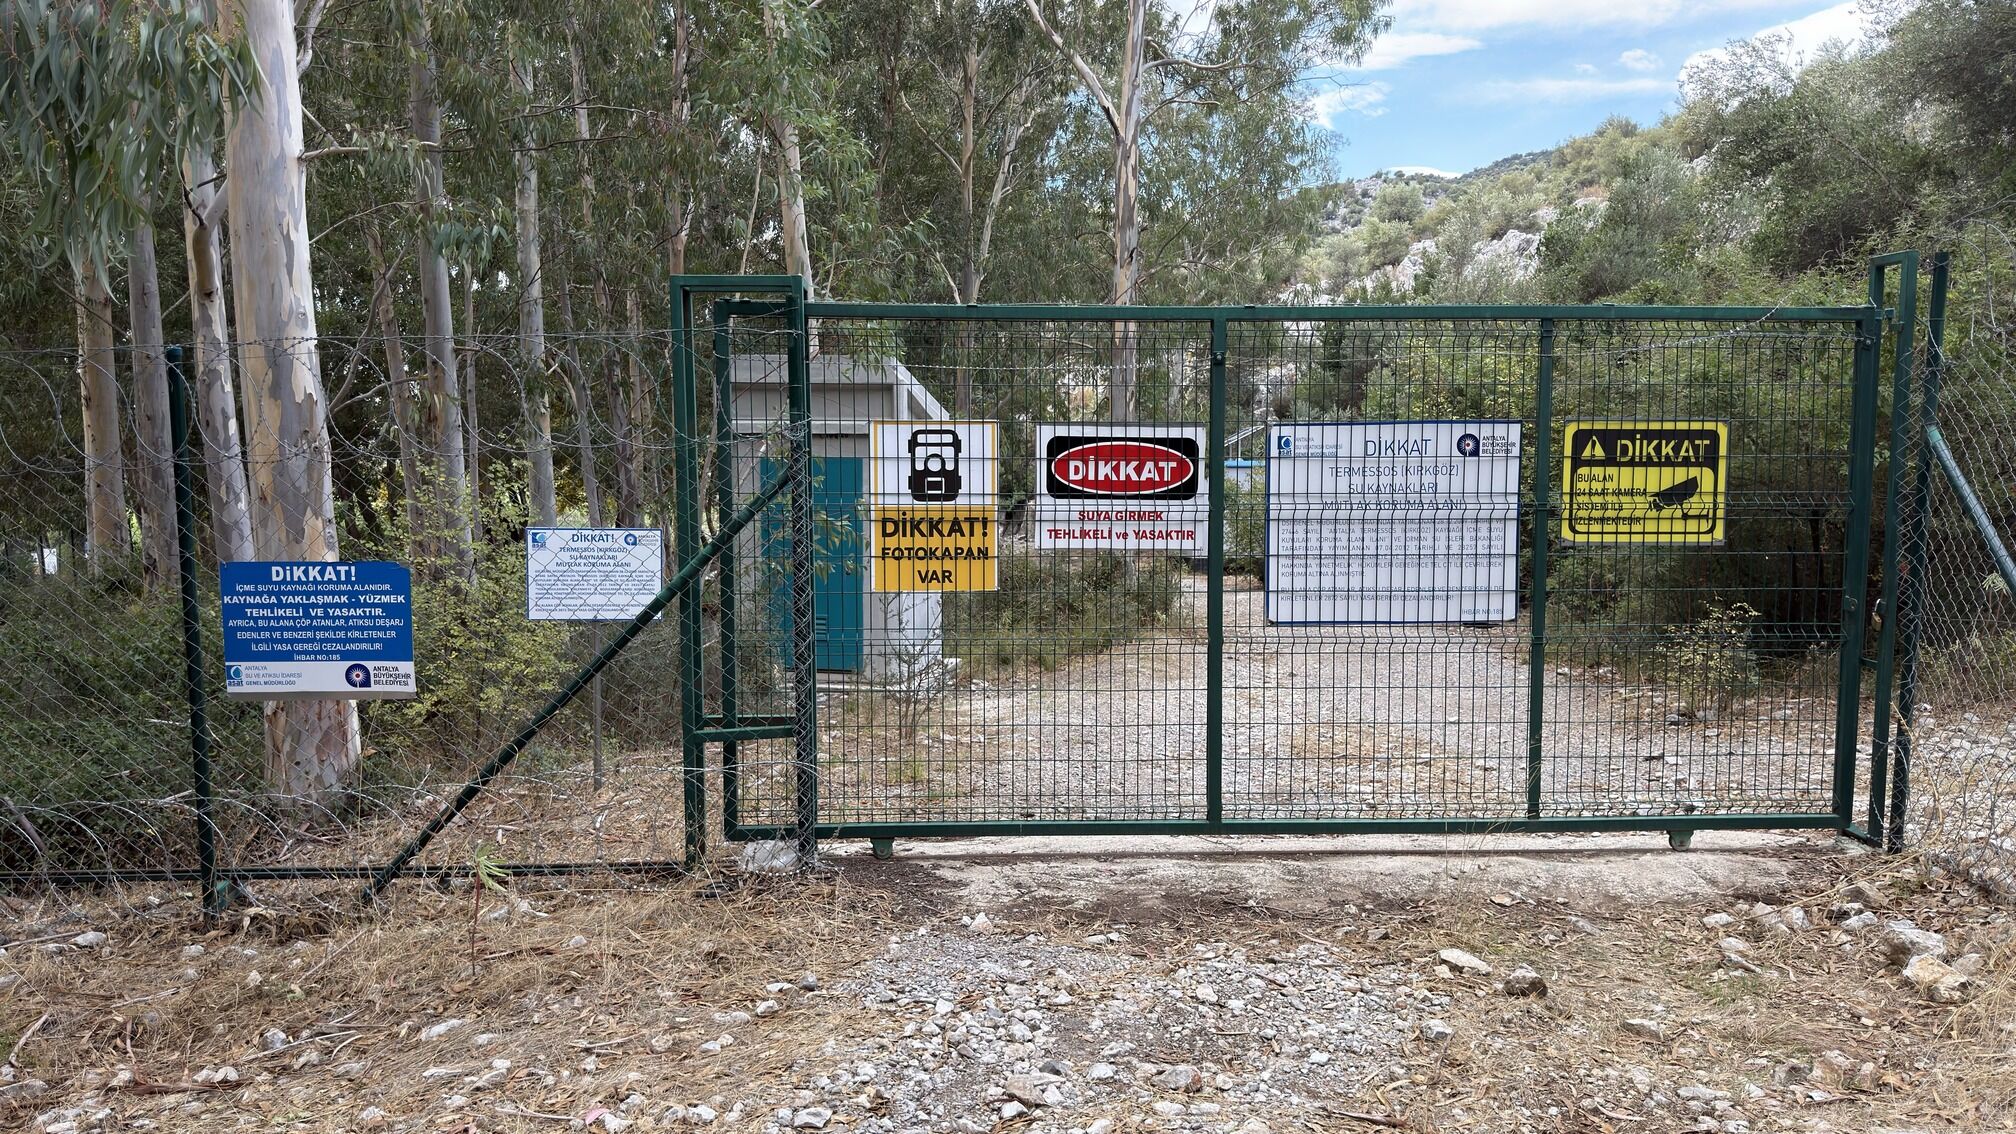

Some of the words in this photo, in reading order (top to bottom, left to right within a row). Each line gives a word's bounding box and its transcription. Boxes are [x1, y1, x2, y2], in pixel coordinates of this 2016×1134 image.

[1365, 437, 1431, 456] DİKKAT
[1617, 434, 1710, 462] DİKKAT
[1069, 456, 1177, 481] DİKKAT
[1329, 466, 1397, 477] TERMESSOS
[1578, 474, 1589, 482] BU
[1591, 474, 1613, 482] ALAN
[1349, 484, 1363, 493] SU
[1368, 482, 1438, 493] KAYNAKLARI
[1577, 488, 1585, 496] 24
[1589, 488, 1609, 496] SAAT
[1612, 488, 1647, 496] KAMERA
[1324, 500, 1371, 510] MUTAK
[1428, 500, 1462, 510] AANI
[1078, 511, 1110, 521] SUYA
[881, 511, 988, 538] DİKKAT!
[571, 532, 615, 542] DİKKAT!
[1047, 527, 1112, 540] TEHLİKELİ
[1116, 531, 1129, 540] ve
[1133, 530, 1194, 540] YASAKTIR
[881, 547, 989, 560] FOTOKAPAN
[917, 570, 953, 583] VAR
[236, 583, 255, 592] İÇME
[281, 583, 315, 591] KAYNAĞI
[224, 593, 277, 604] KAYNAĞA
[281, 595, 348, 605] YAKLAŞMAK
[359, 593, 405, 603] YÜZMEK
[245, 606, 303, 617] TEHLİKELİ
[310, 608, 324, 616] VE
[328, 608, 386, 616] YASAKTIR.
[228, 619, 256, 628] AYRICA,
[295, 618, 310, 628] ÇÖP
[312, 619, 347, 627] ATANLAR,
[376, 619, 404, 627] DEŞARJ
[237, 631, 270, 639] EDENLER
[283, 630, 314, 639] BENZERİ
[316, 630, 346, 640] ŞEKİLDE
[348, 630, 396, 638] KİRLETENLER
[252, 642, 272, 651] İLGİLİ
[294, 642, 321, 650] GEREĞİ
[294, 653, 315, 661] İHBAR
[374, 672, 411, 680] BÜYÜKŞEHİR
